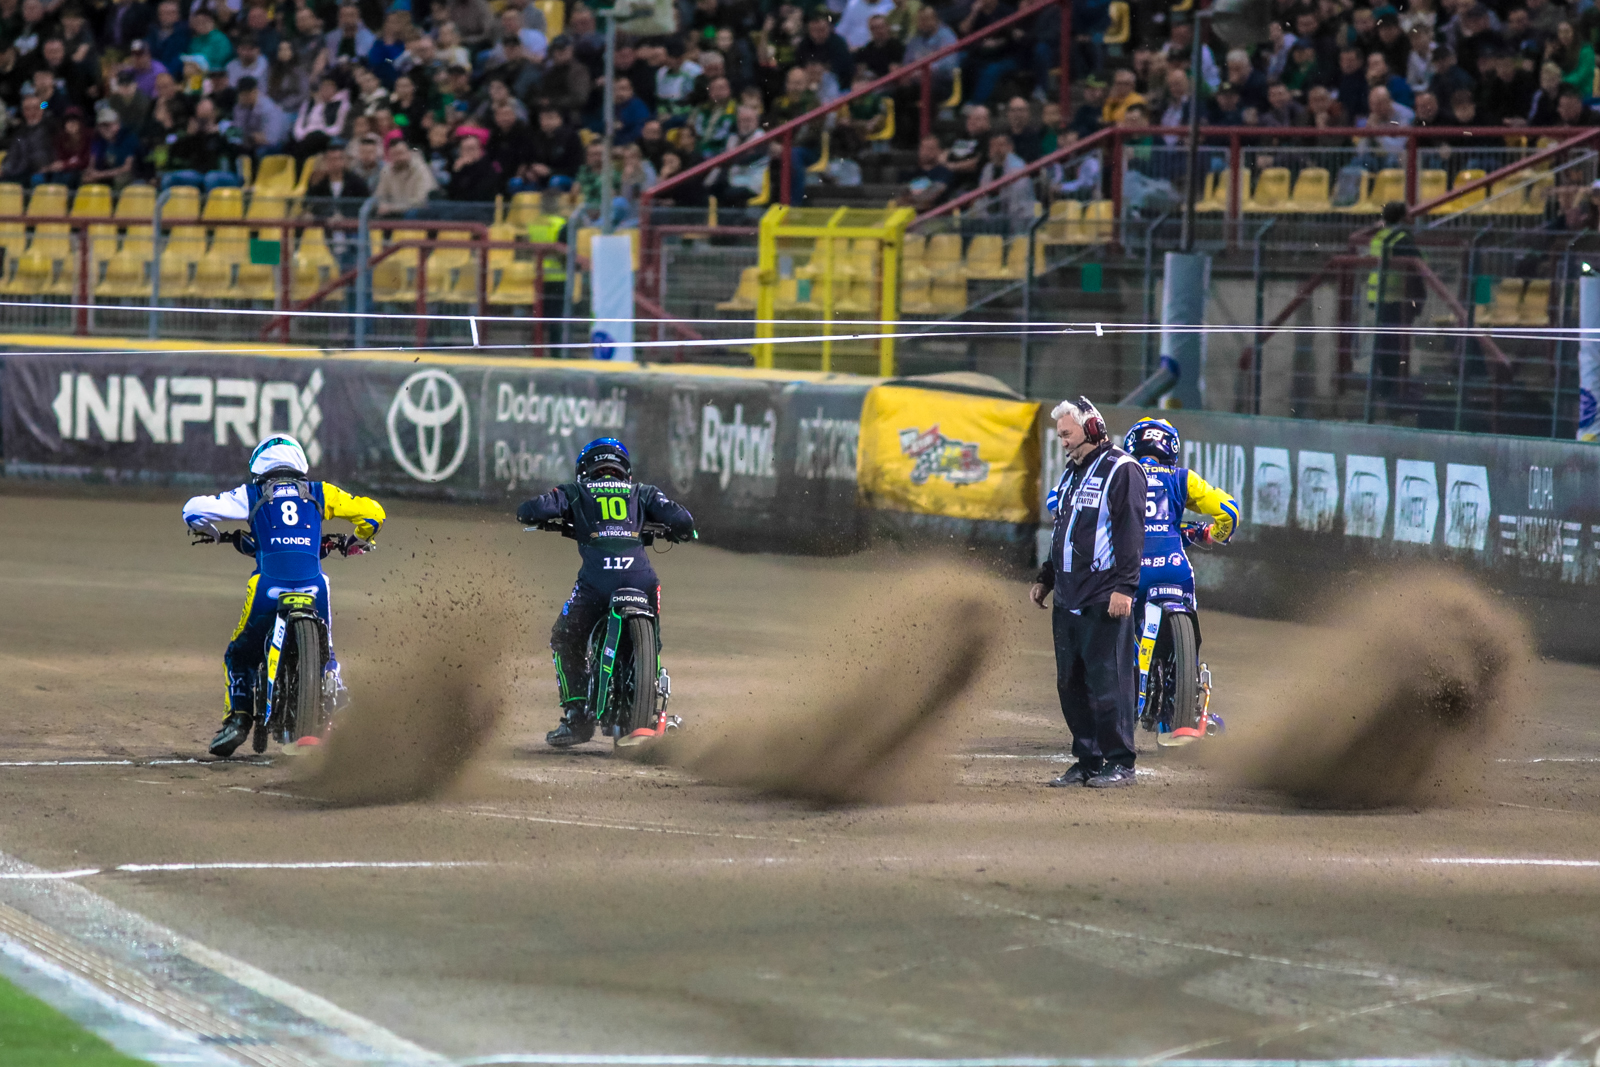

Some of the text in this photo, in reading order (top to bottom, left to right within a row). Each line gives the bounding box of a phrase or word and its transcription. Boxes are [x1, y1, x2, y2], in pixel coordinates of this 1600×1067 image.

[53, 371, 303, 448] INNPRO
[1142, 428, 1164, 441] 89
[280, 500, 299, 526] 8
[596, 496, 628, 521] 10
[282, 536, 311, 546] ONDE
[603, 556, 635, 570] 117
[612, 595, 648, 604] CHUGUNOV
